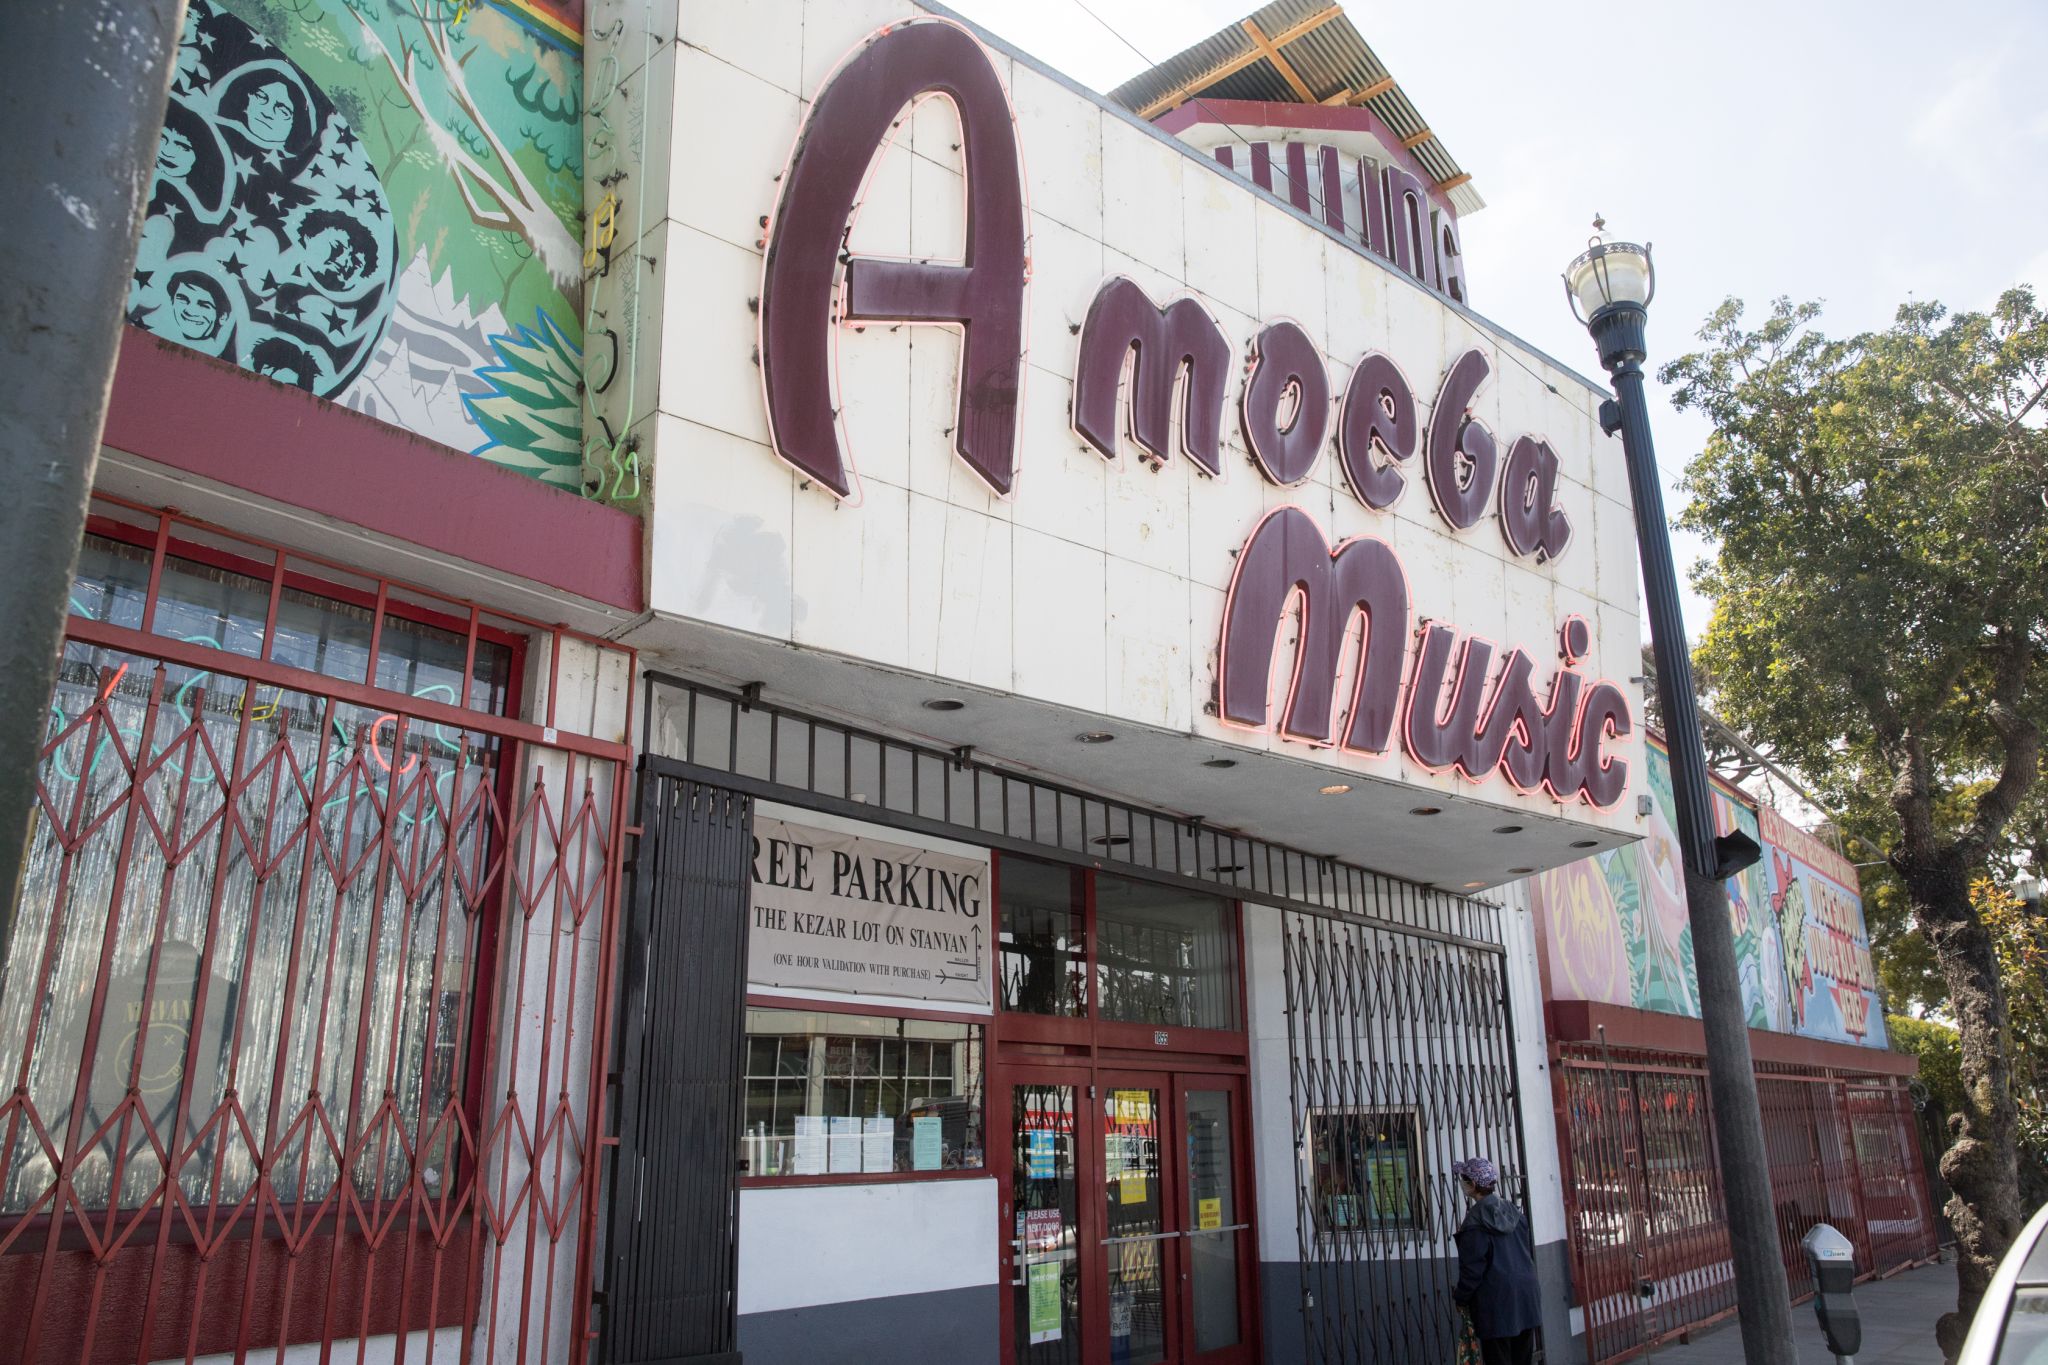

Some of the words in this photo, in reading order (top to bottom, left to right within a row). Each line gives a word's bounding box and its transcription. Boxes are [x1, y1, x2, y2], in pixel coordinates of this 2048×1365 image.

[760, 16, 1574, 564] Amoeba
[1220, 506, 1634, 814] Music
[830, 850, 980, 918] PARKING
[754, 906, 787, 931] THE
[793, 913, 846, 939] KEZAR
[853, 920, 880, 943] LOT
[886, 926, 905, 946] ON
[910, 929, 968, 954] STANYAN
[773, 954, 792, 967] (ONE
[796, 955, 819, 970] HOUR
[822, 957, 866, 973] VALIDATION
[869, 963, 890, 976] WITH
[893, 966, 931, 981] PURCHASE)
[1154, 1031, 1169, 1045] 1855
[1027, 1209, 1048, 1220] PLEASE
[1049, 1208, 1060, 1218] USE
[1027, 1222, 1042, 1233] NEXT
[1043, 1221, 1060, 1232] DOOR
